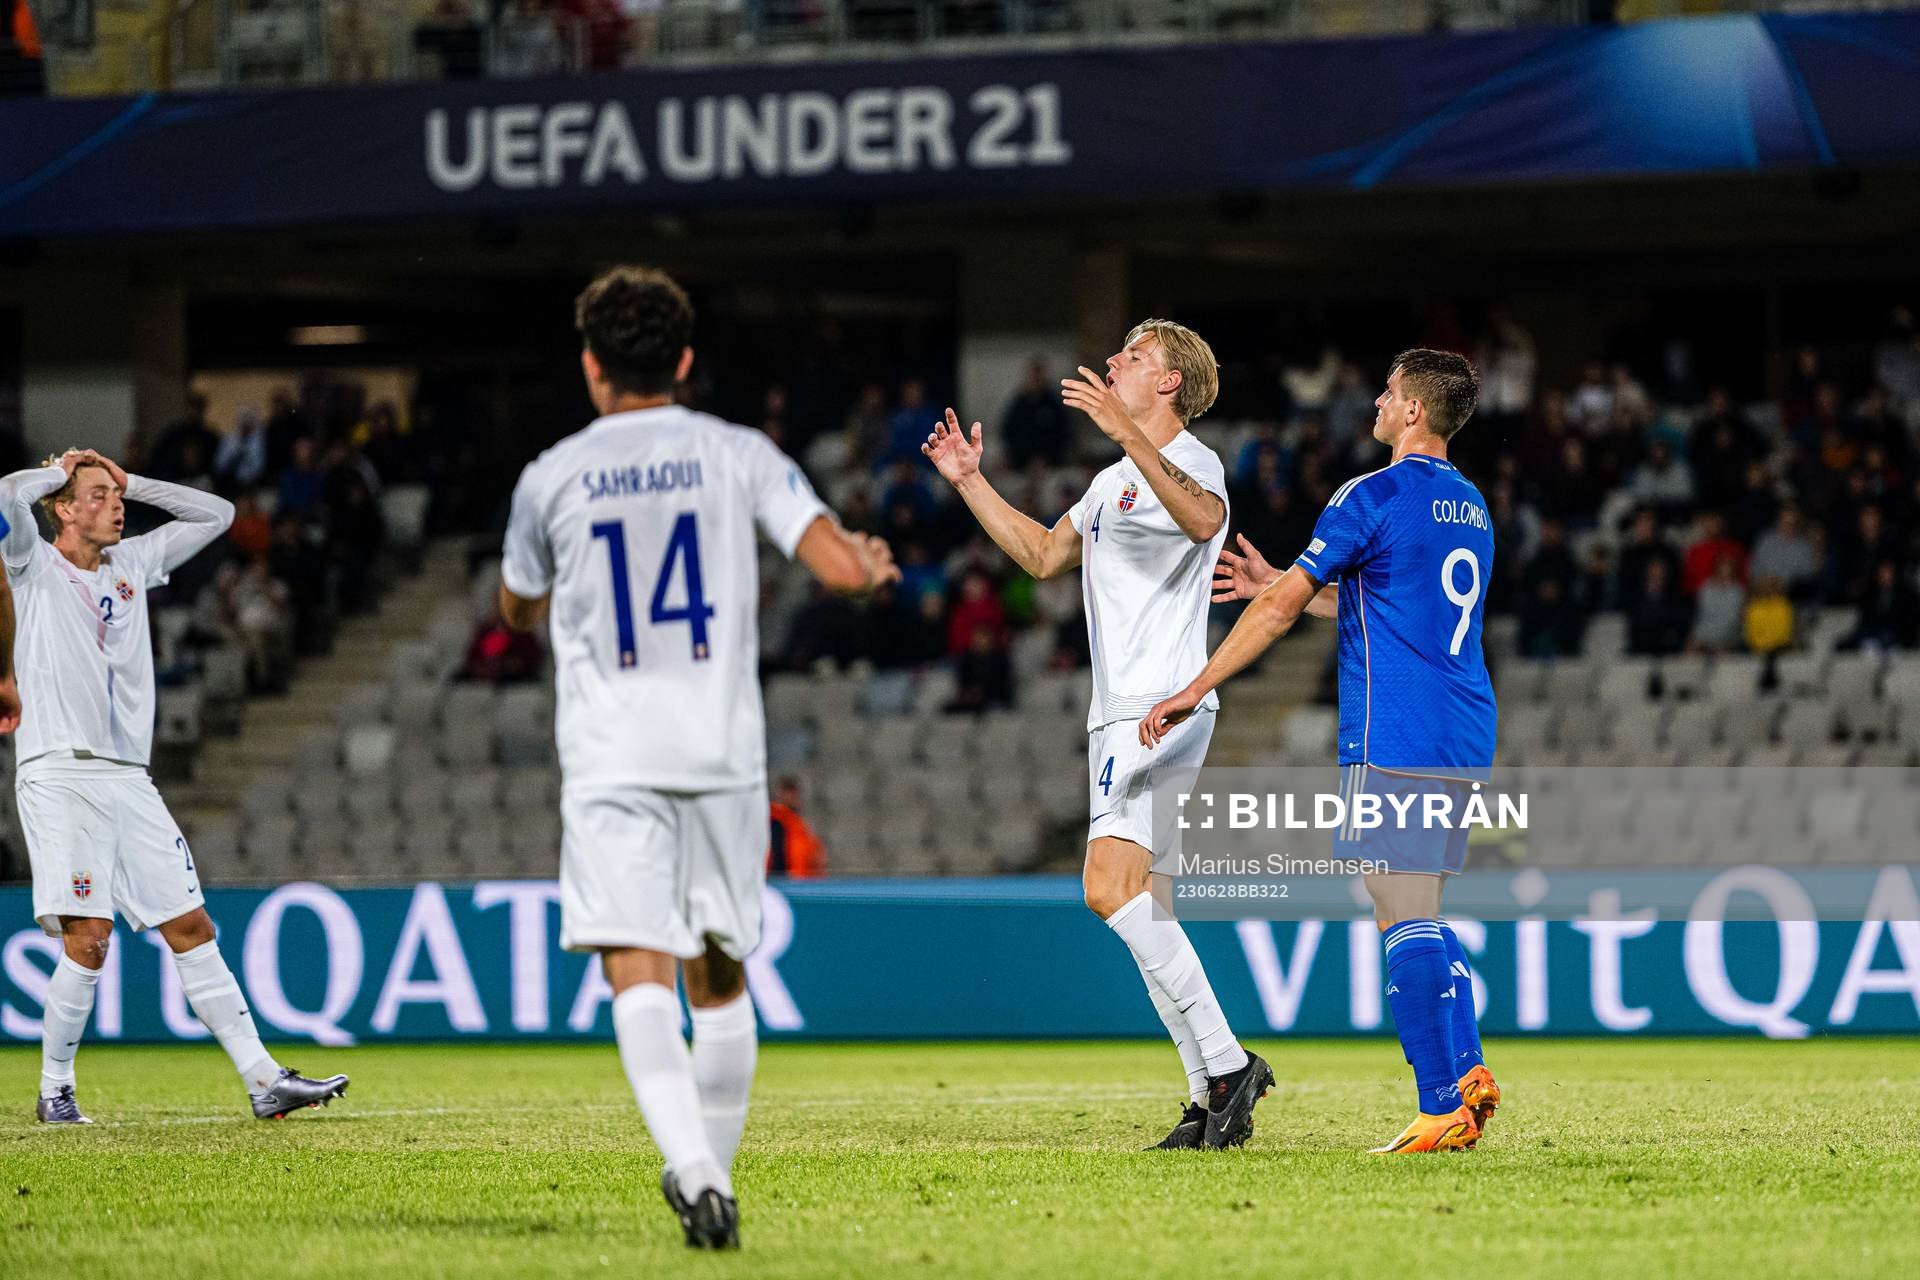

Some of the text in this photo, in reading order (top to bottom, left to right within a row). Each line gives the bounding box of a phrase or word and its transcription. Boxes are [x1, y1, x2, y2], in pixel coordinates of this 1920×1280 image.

[424, 82, 1072, 191] UEFA UNDER 21
[582, 458, 704, 502] SAHRAOUI
[1090, 501, 1105, 542] 4
[1432, 499, 1488, 530] COLOMBO
[99, 596, 114, 625] 2
[591, 510, 715, 670] 14
[1441, 547, 1481, 656] 9
[1098, 755, 1115, 796] 4
[176, 837, 194, 871] 2
